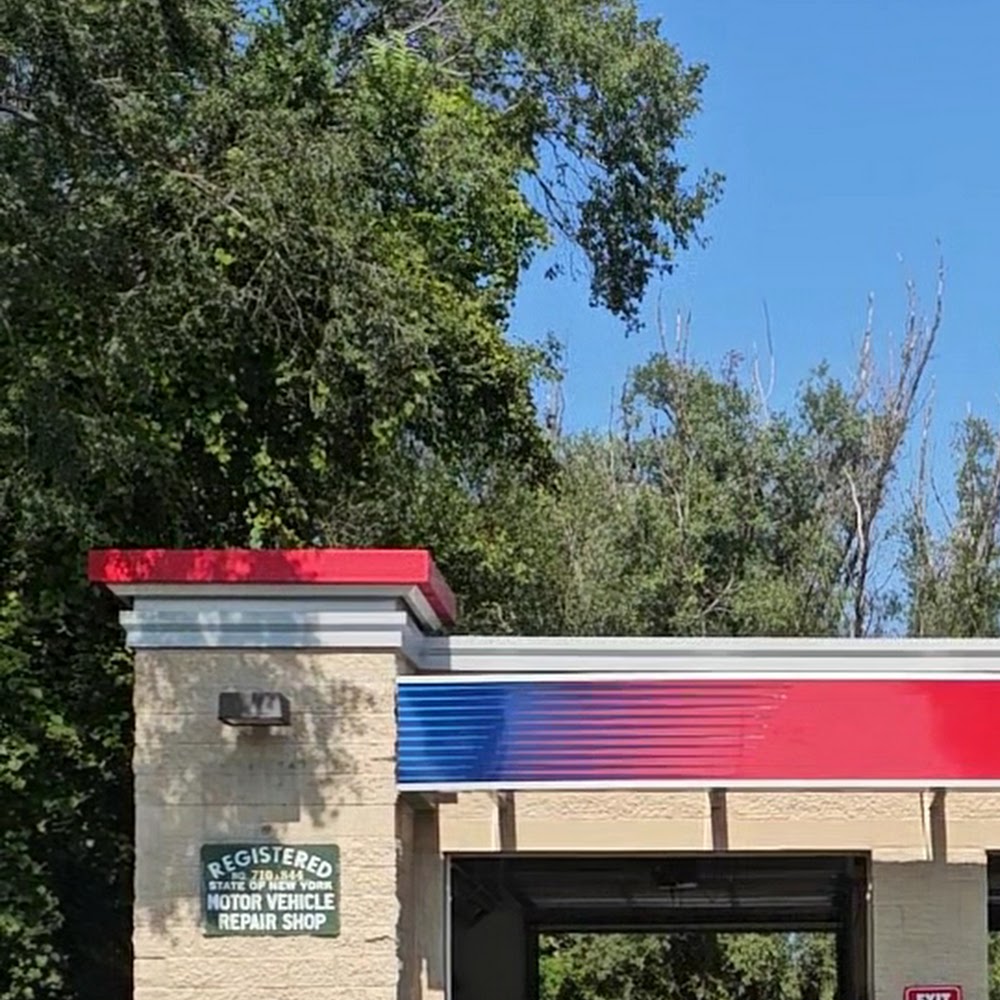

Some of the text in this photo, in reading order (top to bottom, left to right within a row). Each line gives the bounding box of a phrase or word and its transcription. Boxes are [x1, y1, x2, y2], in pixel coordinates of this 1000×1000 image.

[207, 846, 332, 879] REGISTERED
[208, 881, 333, 891] STATE OF NEW YORK
[207, 893, 335, 911] MOTOR VEHICLE
[218, 913, 327, 930] REPAIR SHOP
